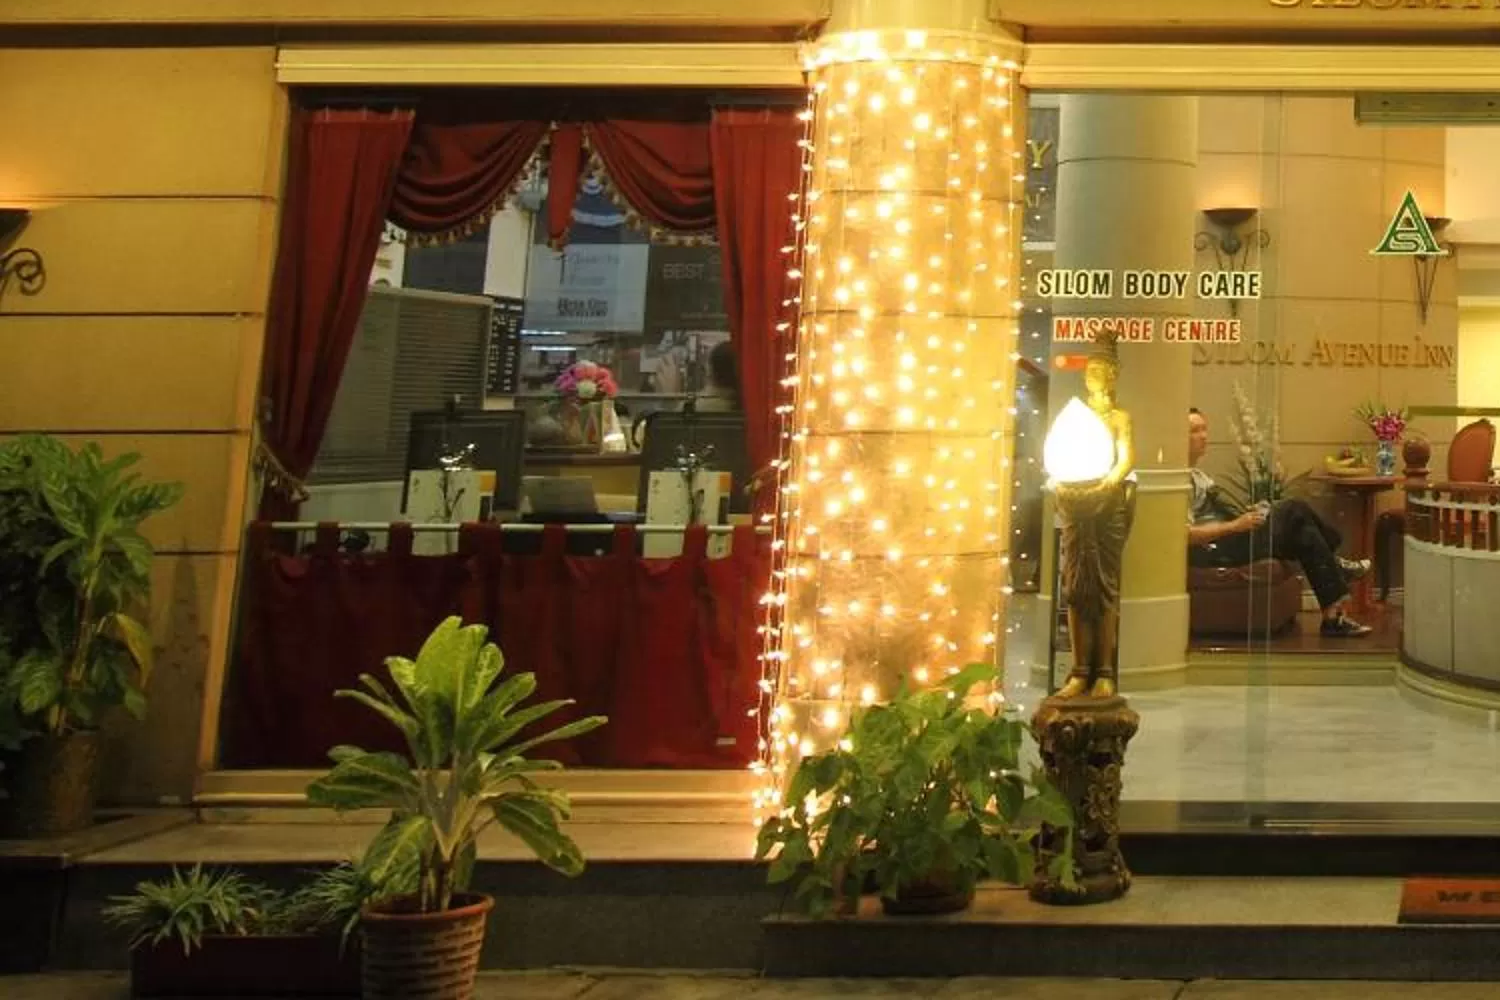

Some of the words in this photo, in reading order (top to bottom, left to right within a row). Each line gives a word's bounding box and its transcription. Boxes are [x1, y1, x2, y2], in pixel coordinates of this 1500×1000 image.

[1038, 270, 1112, 297] SILOM
[1124, 272, 1189, 297] BODY
[1200, 272, 1261, 298] CARE
[1164, 319, 1241, 342] CENTRE
[1302, 338, 1408, 367] AVENUE
